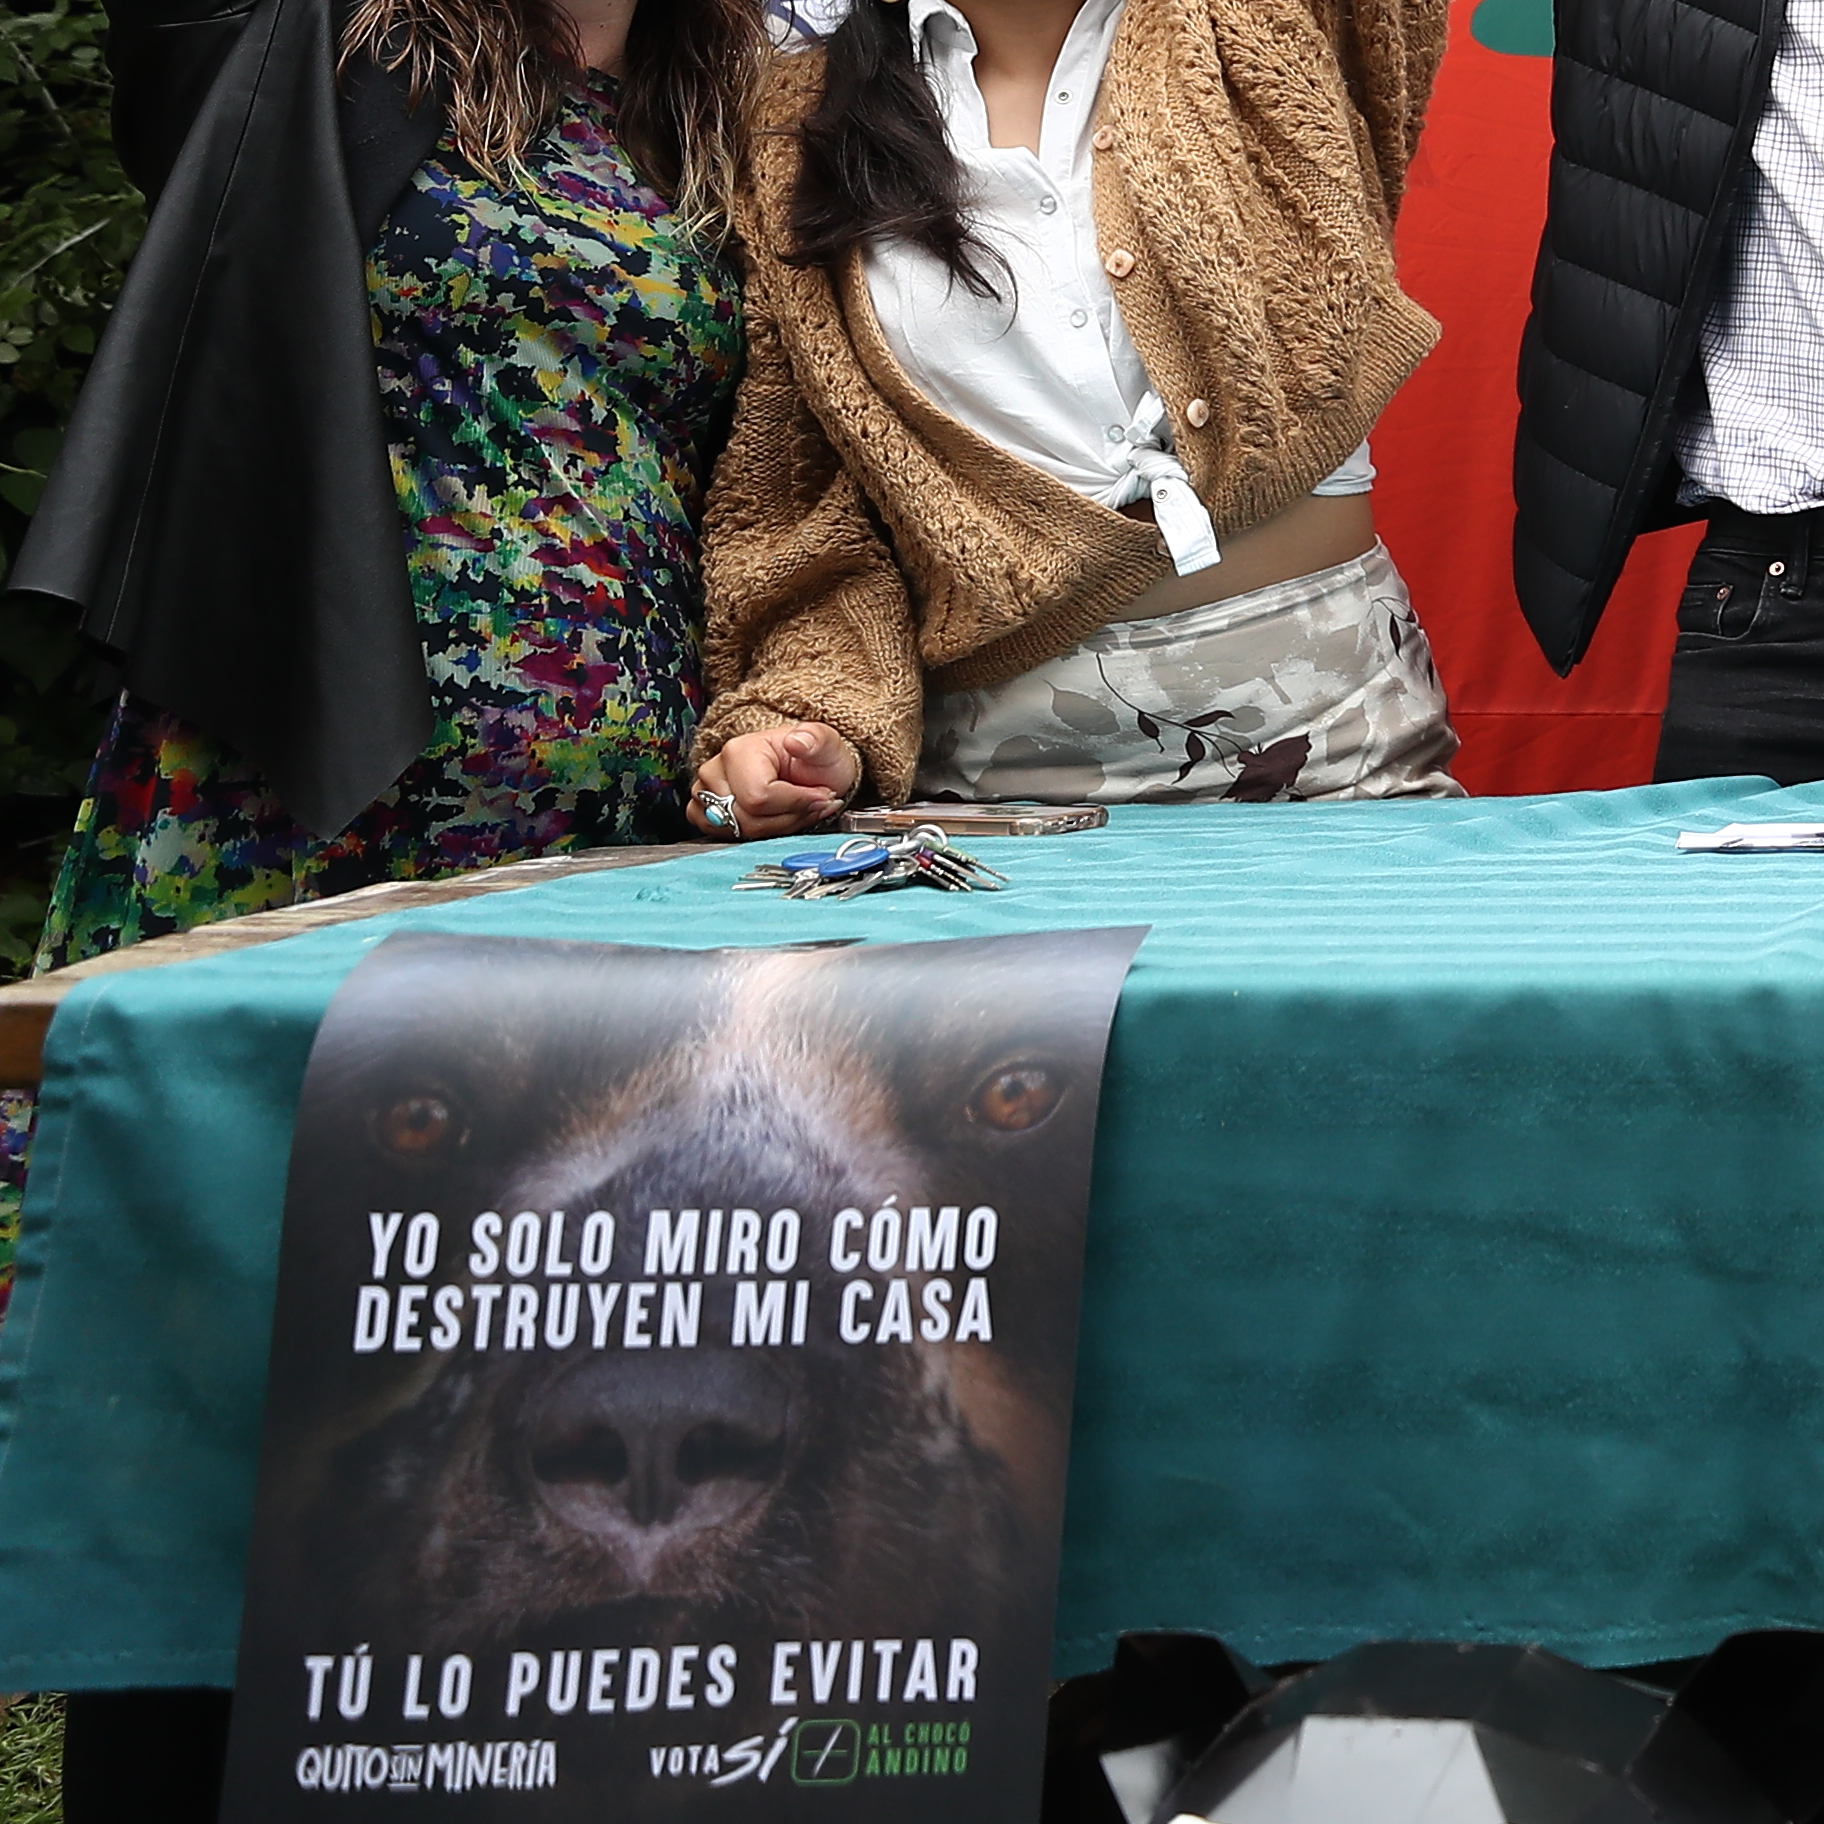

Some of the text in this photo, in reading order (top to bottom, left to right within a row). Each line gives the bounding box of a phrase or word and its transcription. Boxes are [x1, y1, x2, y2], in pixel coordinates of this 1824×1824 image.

[370, 1195, 998, 1279] YO SOLO MIRO CÓMO
[355, 1278, 991, 1351] DESTRUYEN MI CASA
[304, 1639, 977, 1720] TÚ LO PUEDES EVITAR
[649, 1744, 719, 1778] VOTA
[865, 1746, 969, 1776] ANDINO
[866, 1724, 892, 1746] AL
